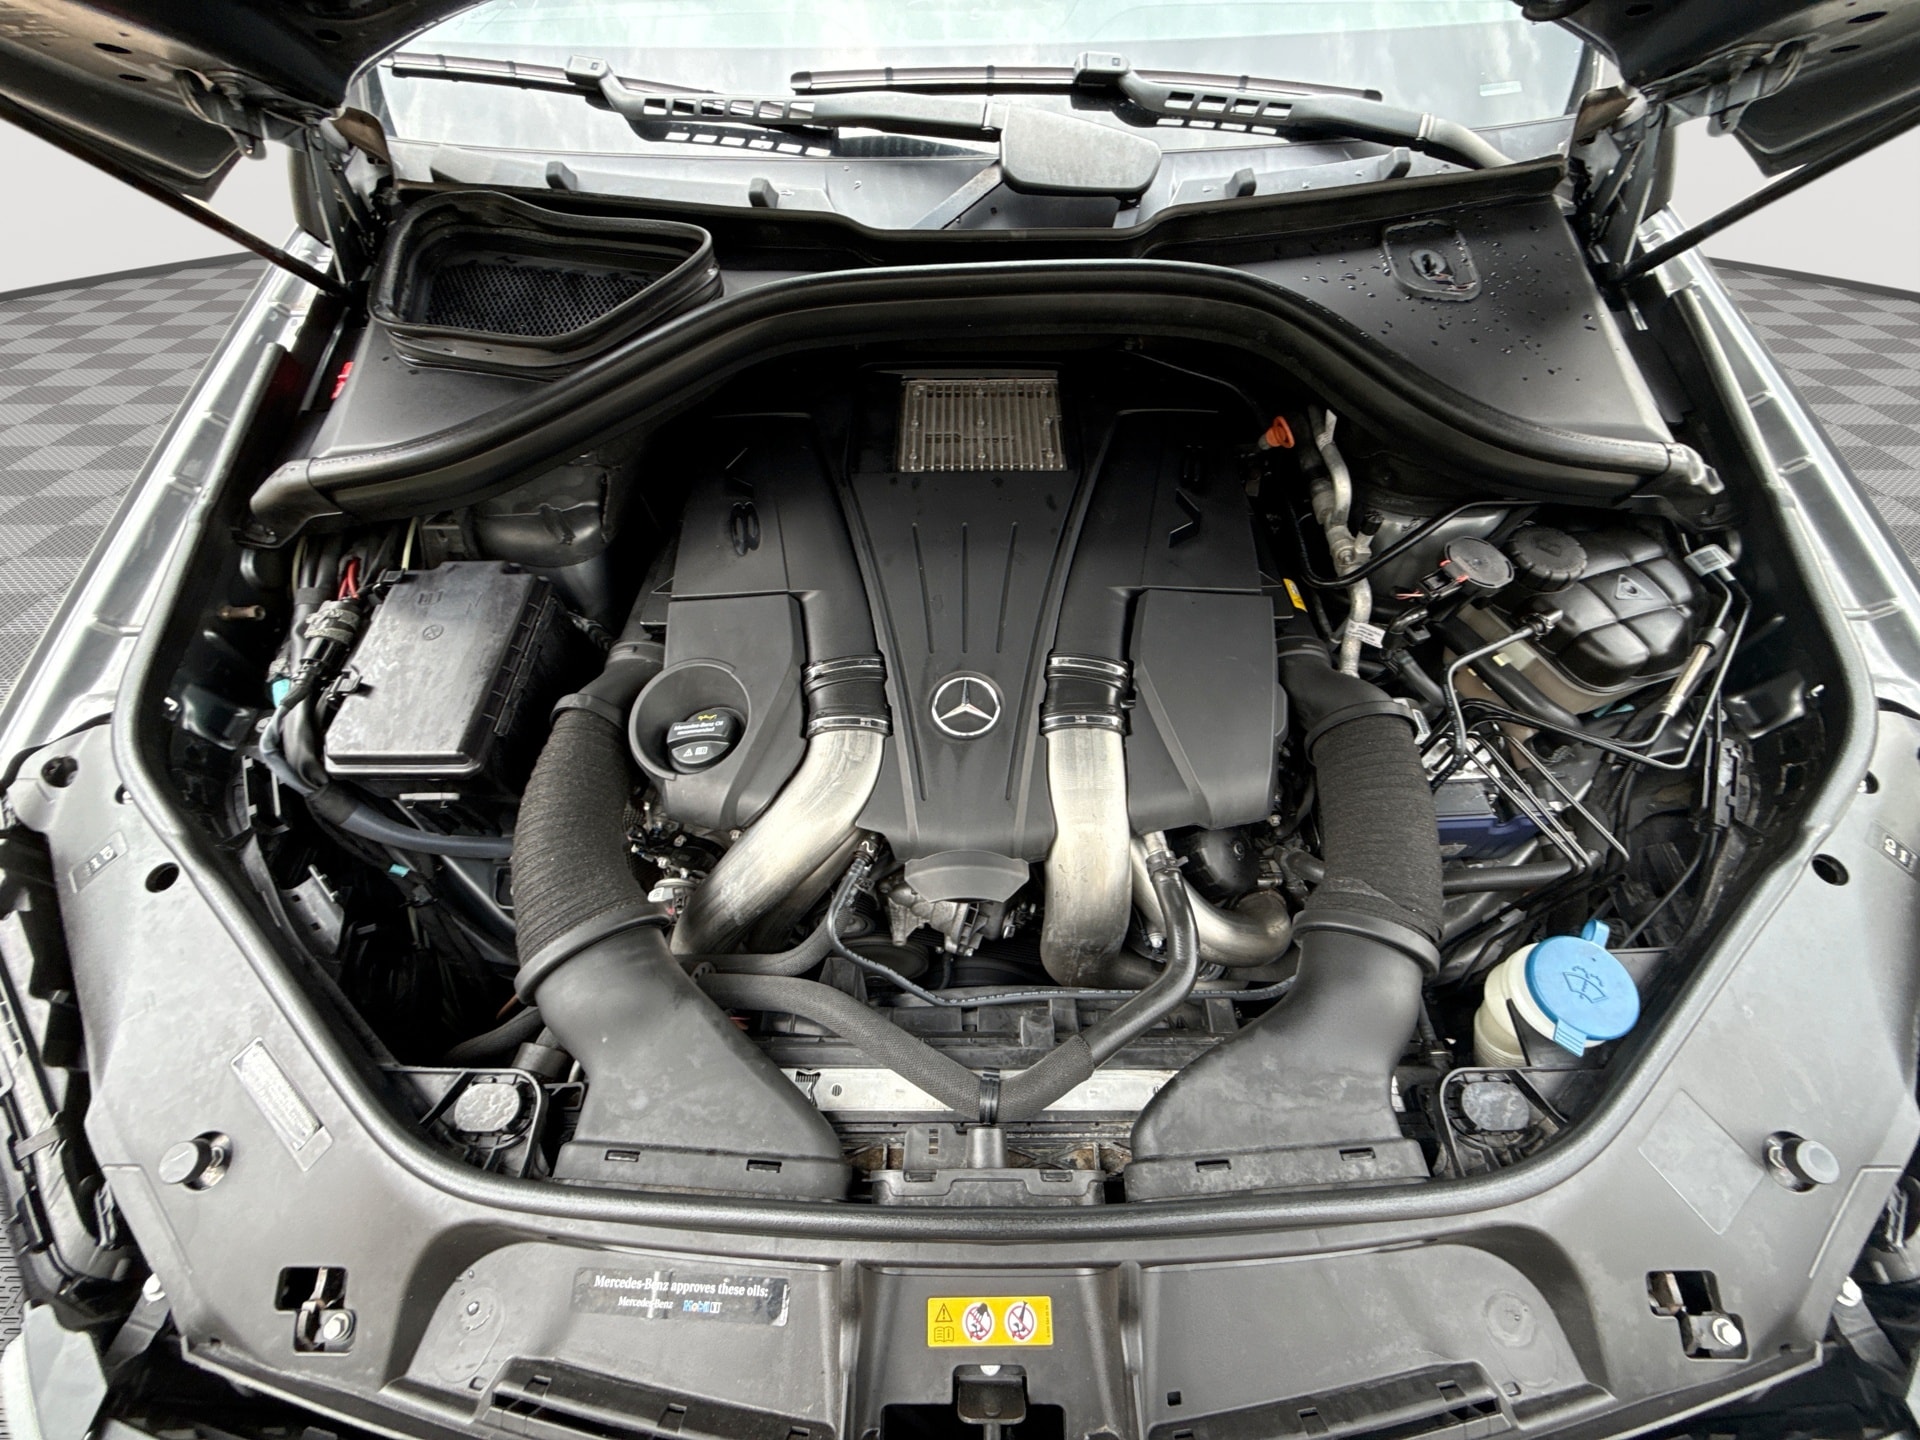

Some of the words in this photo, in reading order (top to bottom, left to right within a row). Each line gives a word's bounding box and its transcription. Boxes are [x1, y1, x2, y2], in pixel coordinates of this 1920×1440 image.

[594, 1275, 669, 1292] Mercedes-Benz
[671, 1282, 716, 1295] approves
[717, 1282, 745, 1295] these
[746, 1284, 769, 1297] oils:
[618, 1296, 674, 1309] Mercedes-Benz
